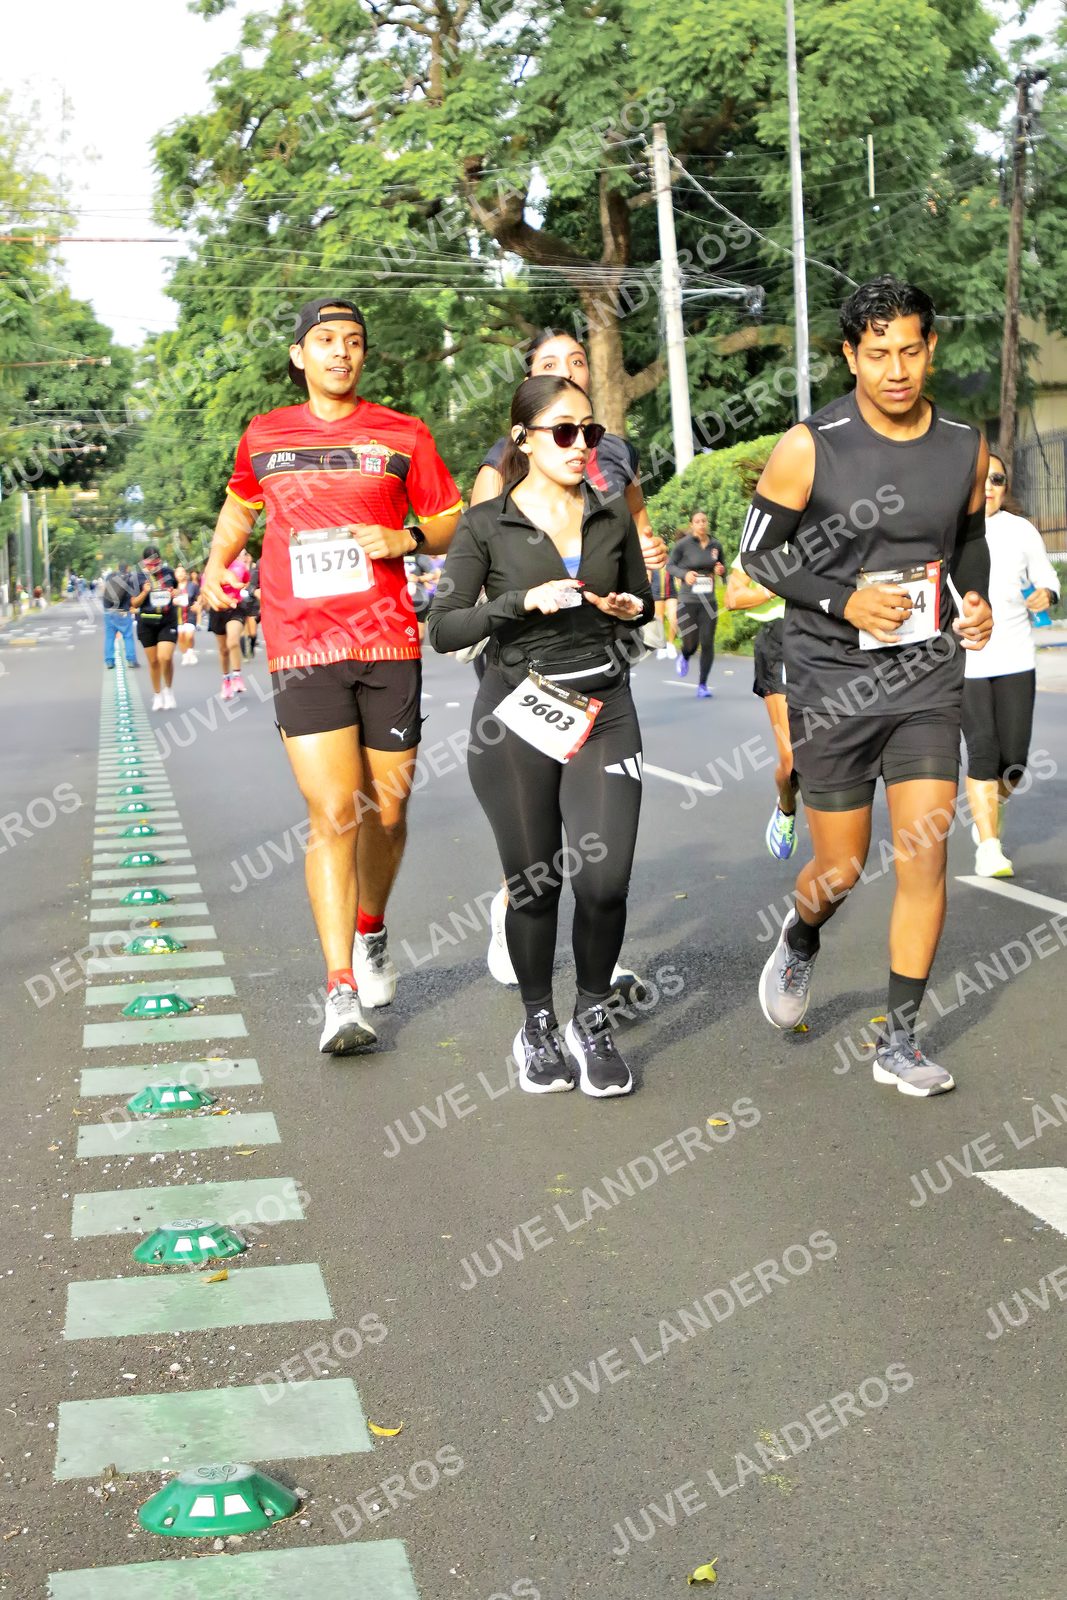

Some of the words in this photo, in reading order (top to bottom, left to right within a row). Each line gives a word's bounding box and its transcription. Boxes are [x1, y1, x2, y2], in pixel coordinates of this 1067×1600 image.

[296, 547, 360, 575] 11579
[908, 590, 926, 613] 4
[518, 694, 576, 732] 9603
